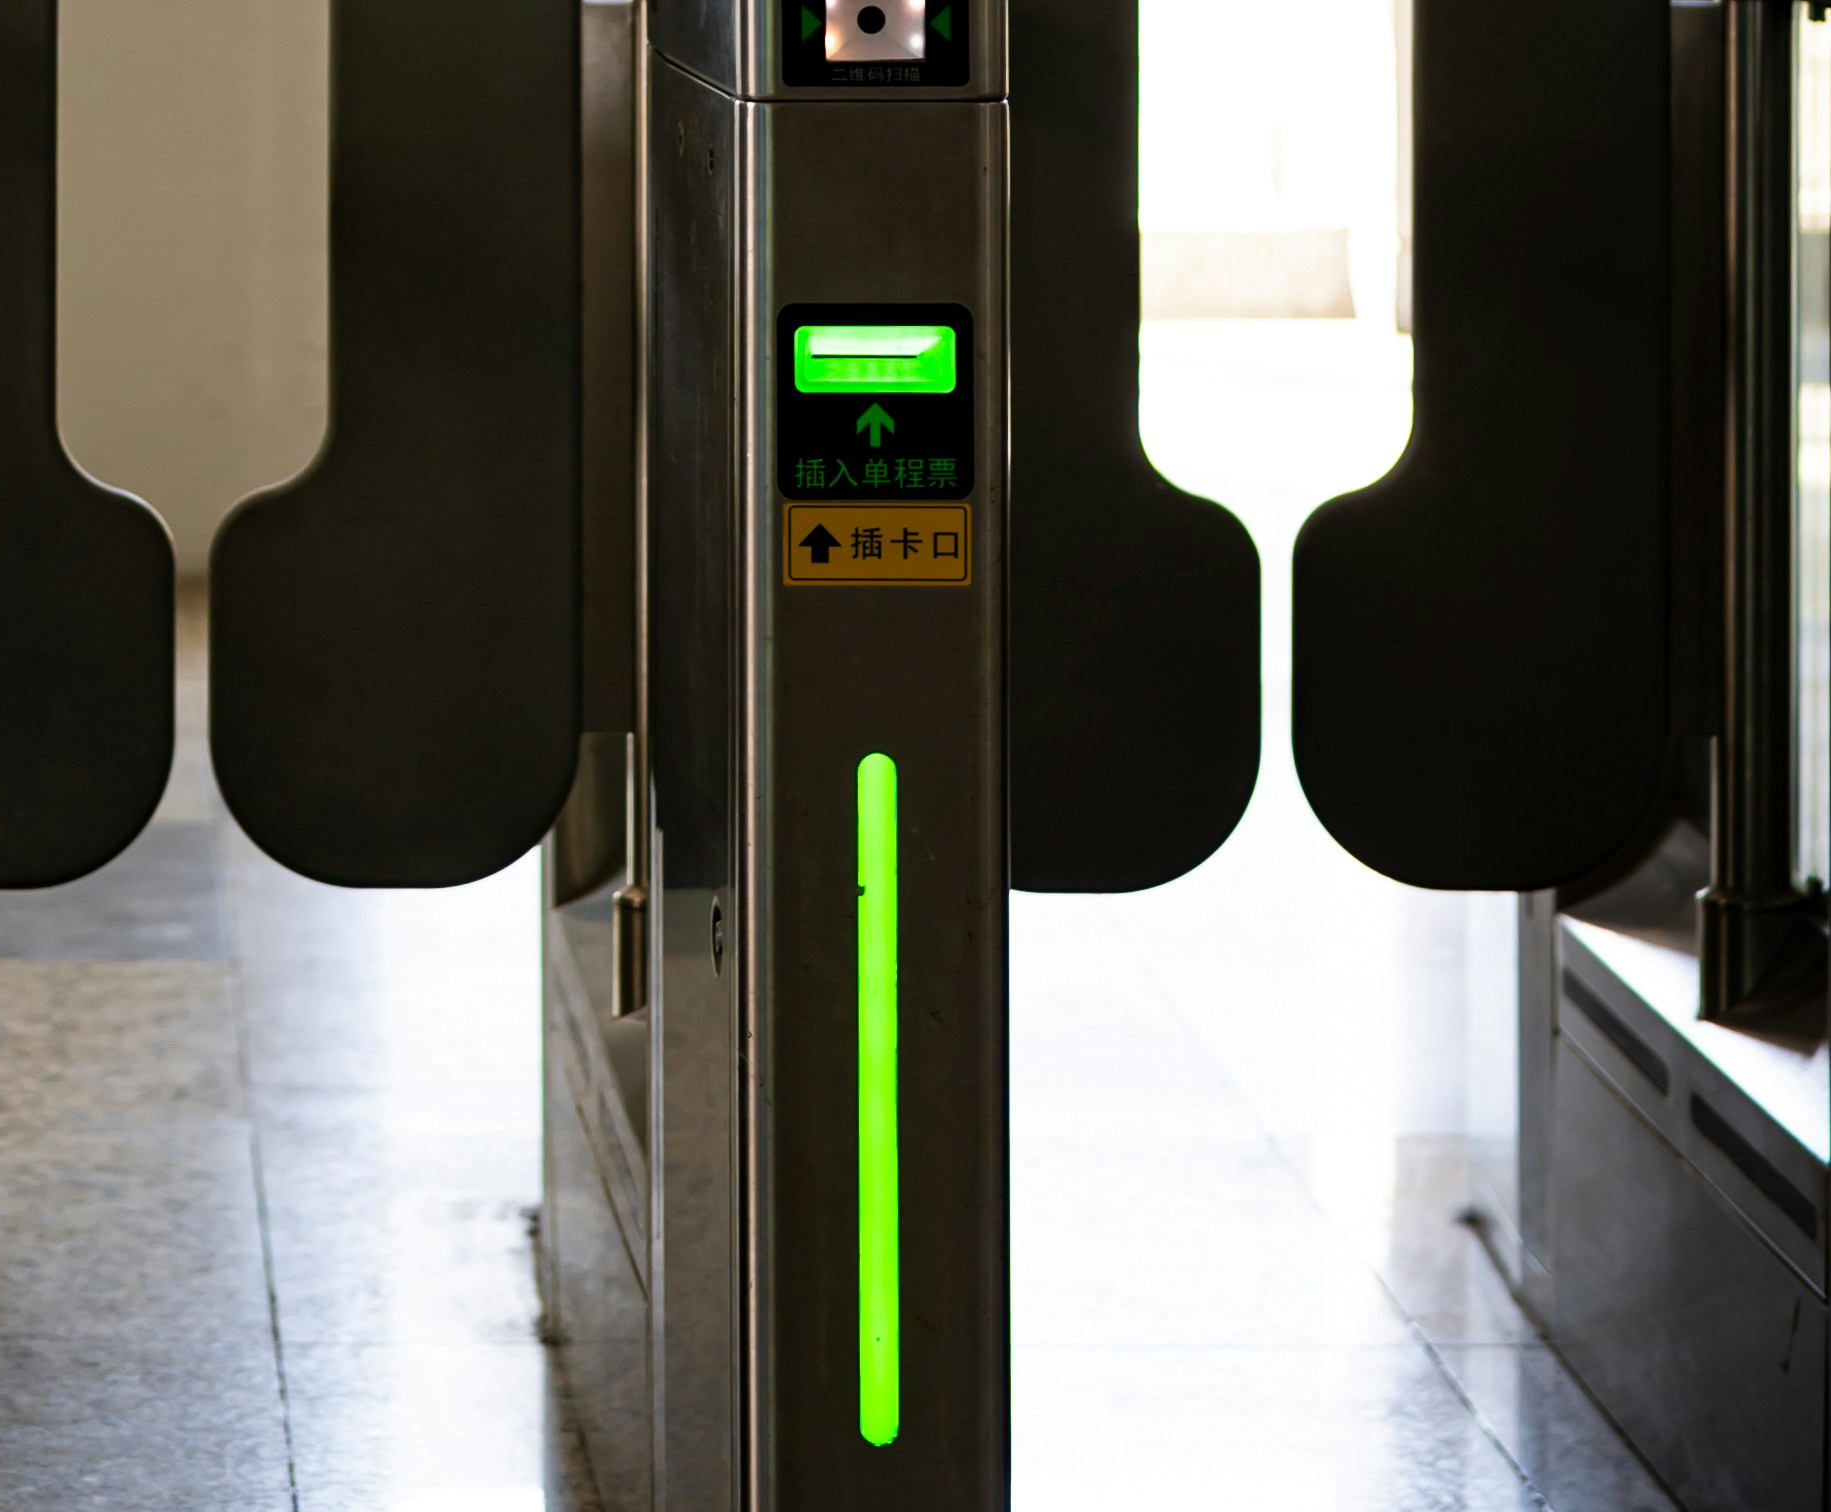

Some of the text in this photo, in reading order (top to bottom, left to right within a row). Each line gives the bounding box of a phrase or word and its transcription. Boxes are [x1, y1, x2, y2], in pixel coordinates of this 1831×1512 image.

[831, 66, 921, 82] 二维码扫描
[795, 458, 958, 488] 插入单程票
[851, 527, 958, 559] 插卡口
